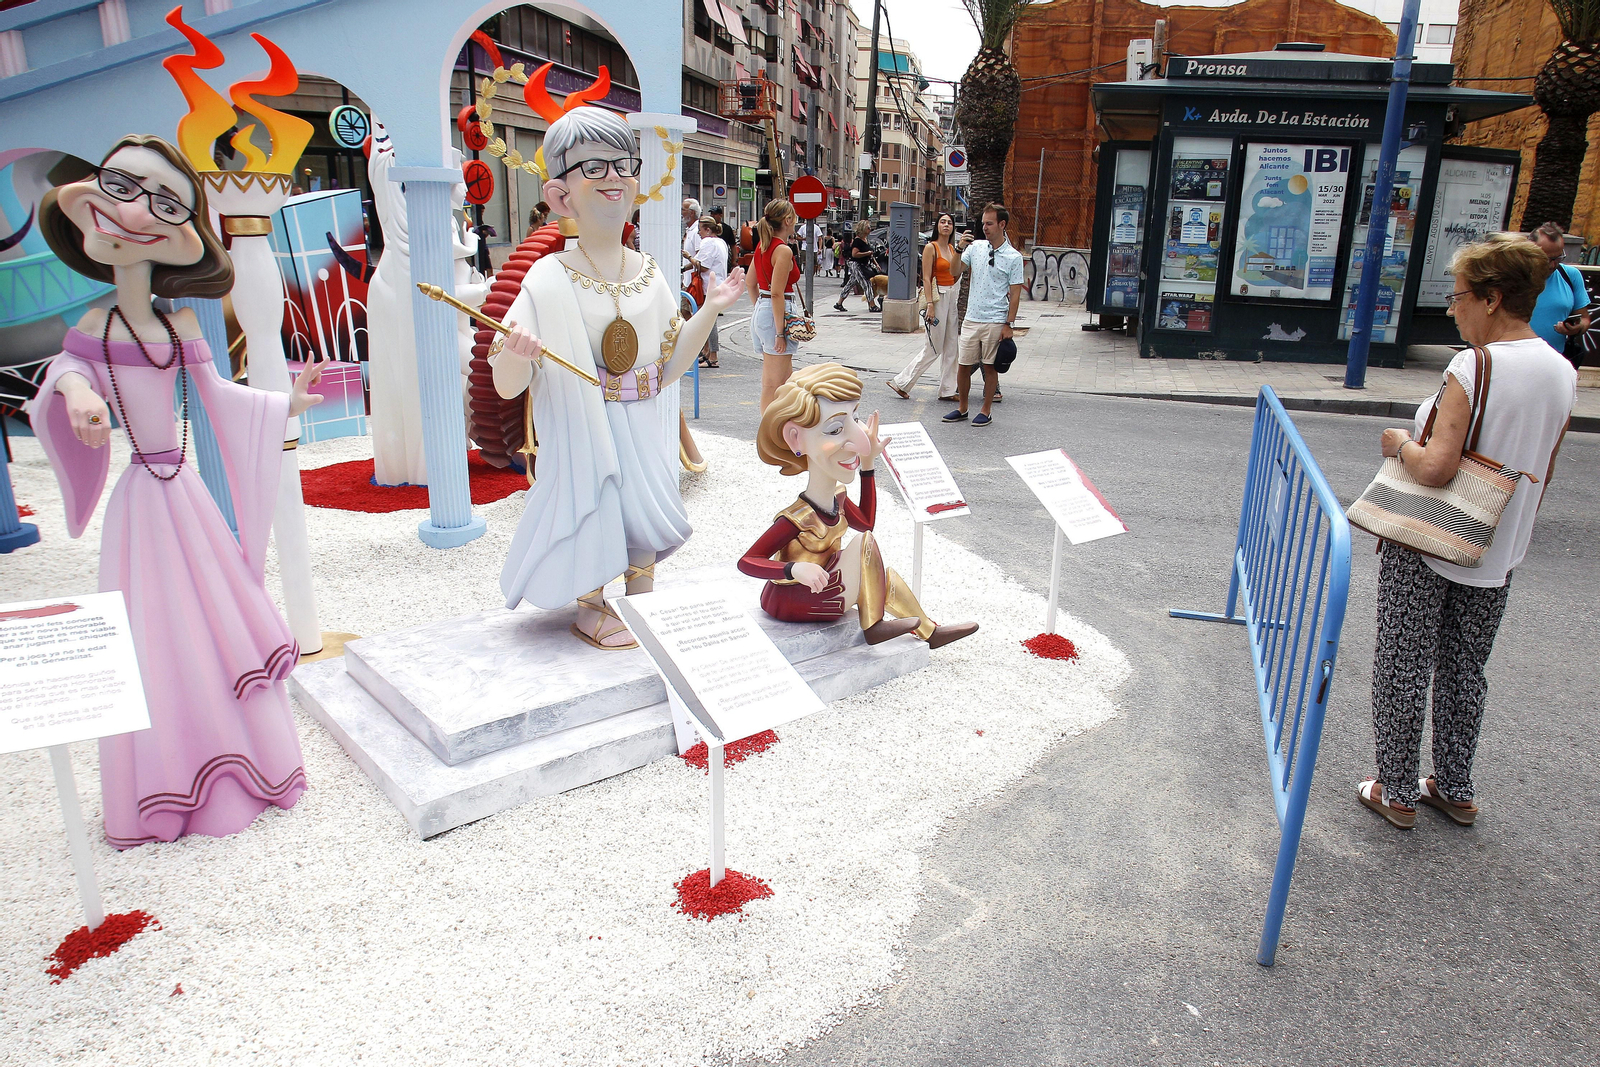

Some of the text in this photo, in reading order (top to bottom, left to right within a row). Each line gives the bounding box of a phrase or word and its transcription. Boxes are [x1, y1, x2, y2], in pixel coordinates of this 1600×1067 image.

[1185, 60, 1247, 76] Prensa
[1208, 108, 1370, 128] Avda. De La Estación
[1304, 148, 1350, 172] IBI
[1445, 169, 1477, 178] ALICANTE
[1434, 190, 1443, 210] 2022
[1493, 202, 1502, 224] PLAZA
[1430, 210, 1440, 239] AGOSTO
[1426, 245, 1434, 265] MAYO
[61, 621, 106, 631] Honorable
[66, 616, 104, 625] concrets
[90, 625, 117, 633] viable
[3, 642, 24, 650] anar
[26, 638, 56, 648] jugant
[87, 644, 107, 652] edat
[47, 674, 86, 682] haciendo
[71, 676, 114, 686] Honorable
[92, 703, 114, 712] edad
